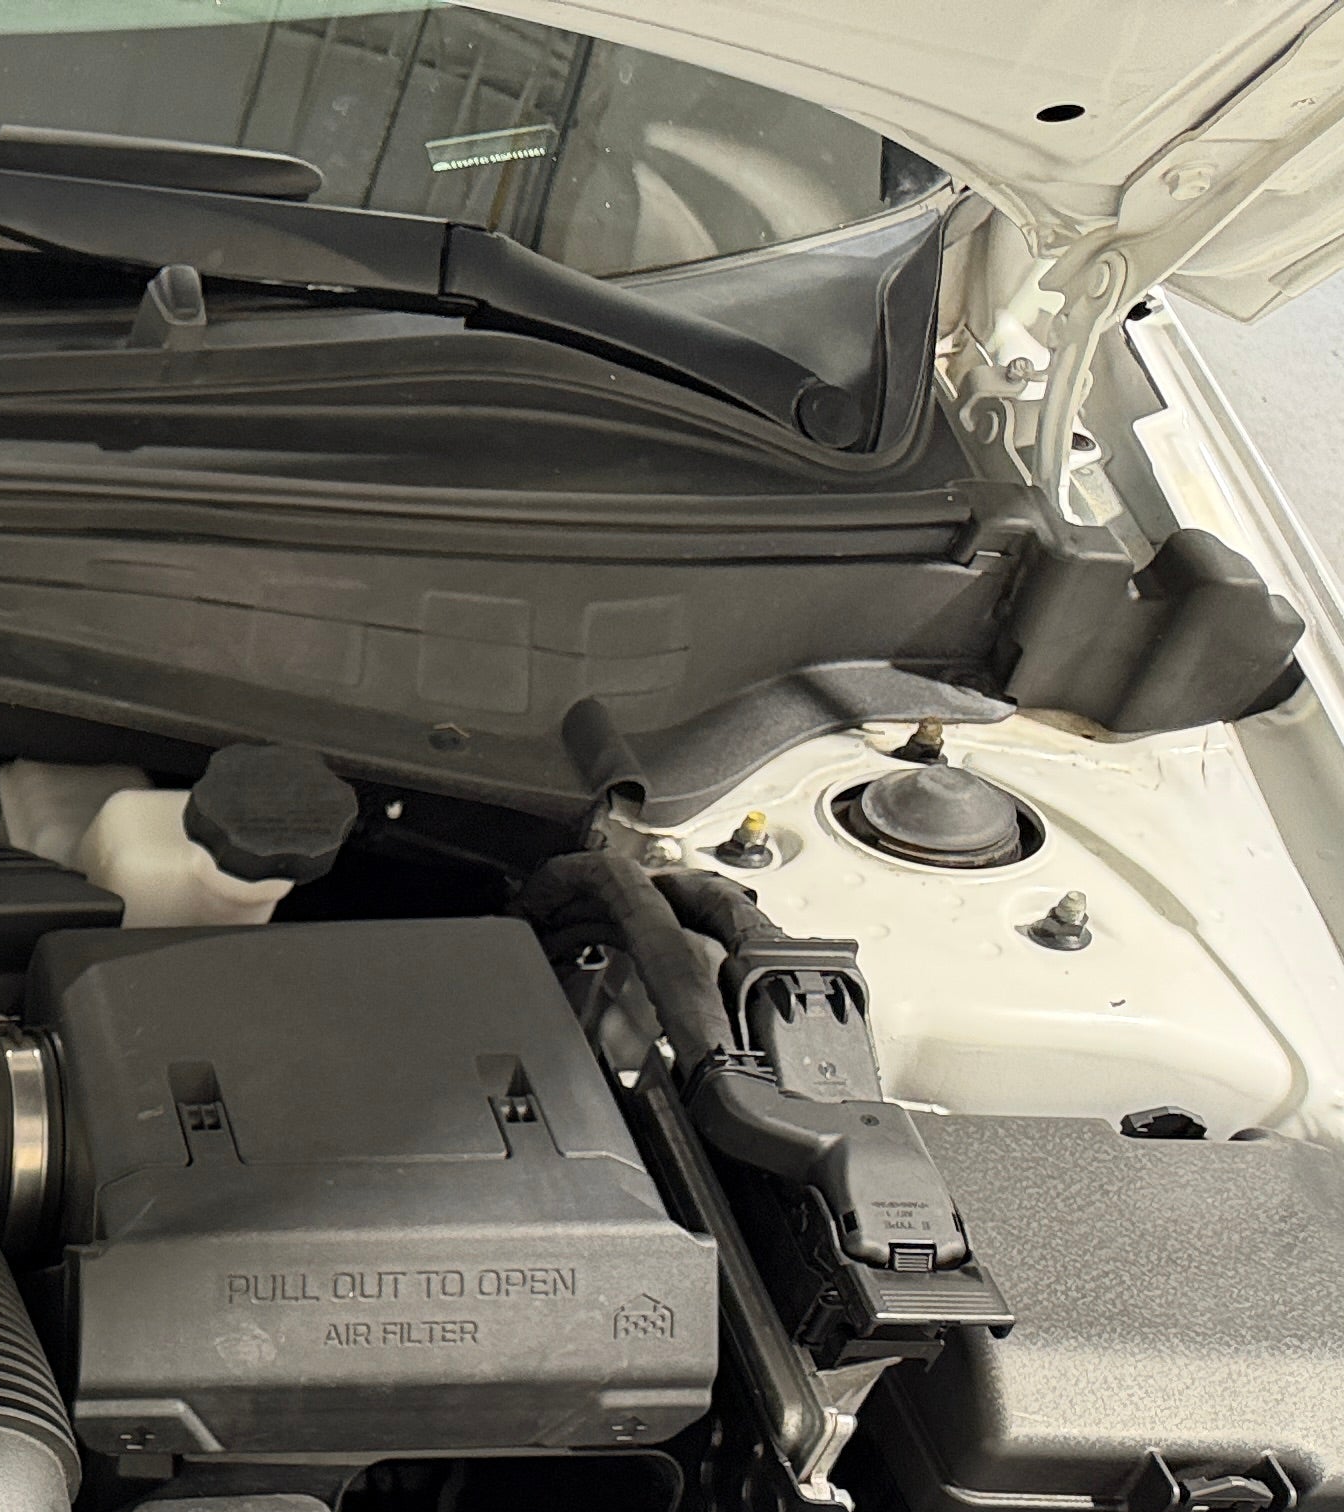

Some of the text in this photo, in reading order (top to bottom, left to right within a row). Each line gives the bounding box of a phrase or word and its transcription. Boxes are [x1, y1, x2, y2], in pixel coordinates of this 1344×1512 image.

[227, 1268, 577, 1303] PULL OUT TO OPEN
[324, 1320, 479, 1346] AIR FILTER
